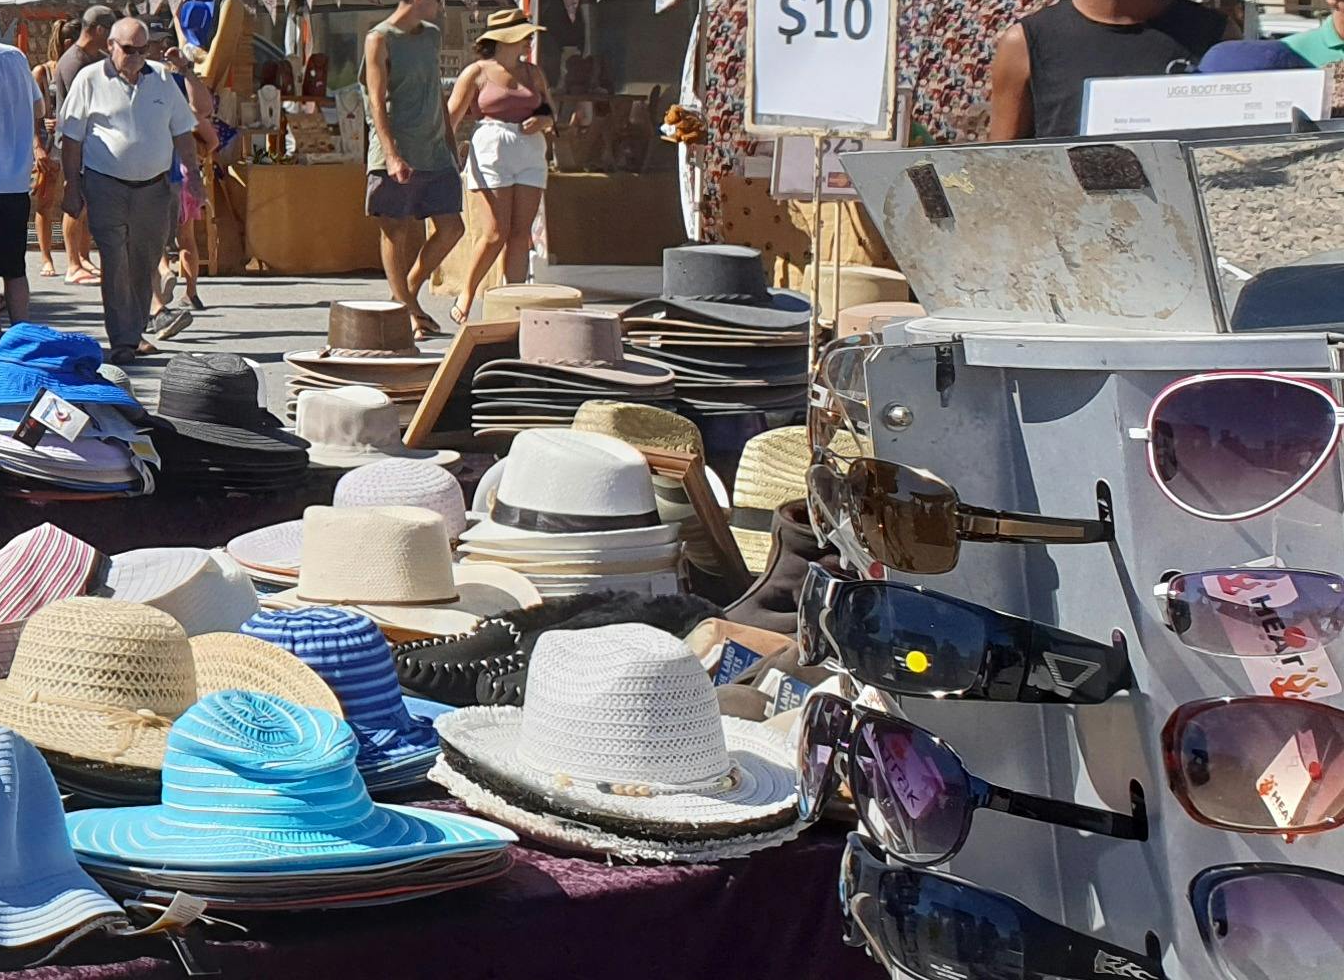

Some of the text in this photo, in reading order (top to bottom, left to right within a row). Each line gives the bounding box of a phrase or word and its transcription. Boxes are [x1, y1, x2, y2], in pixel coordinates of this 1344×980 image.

[1167, 83, 1253, 96] UGG BOOT PRICES
[1250, 594, 1305, 666] HEAT
[722, 646, 736, 671] LAND
[778, 681, 793, 711] LAND
